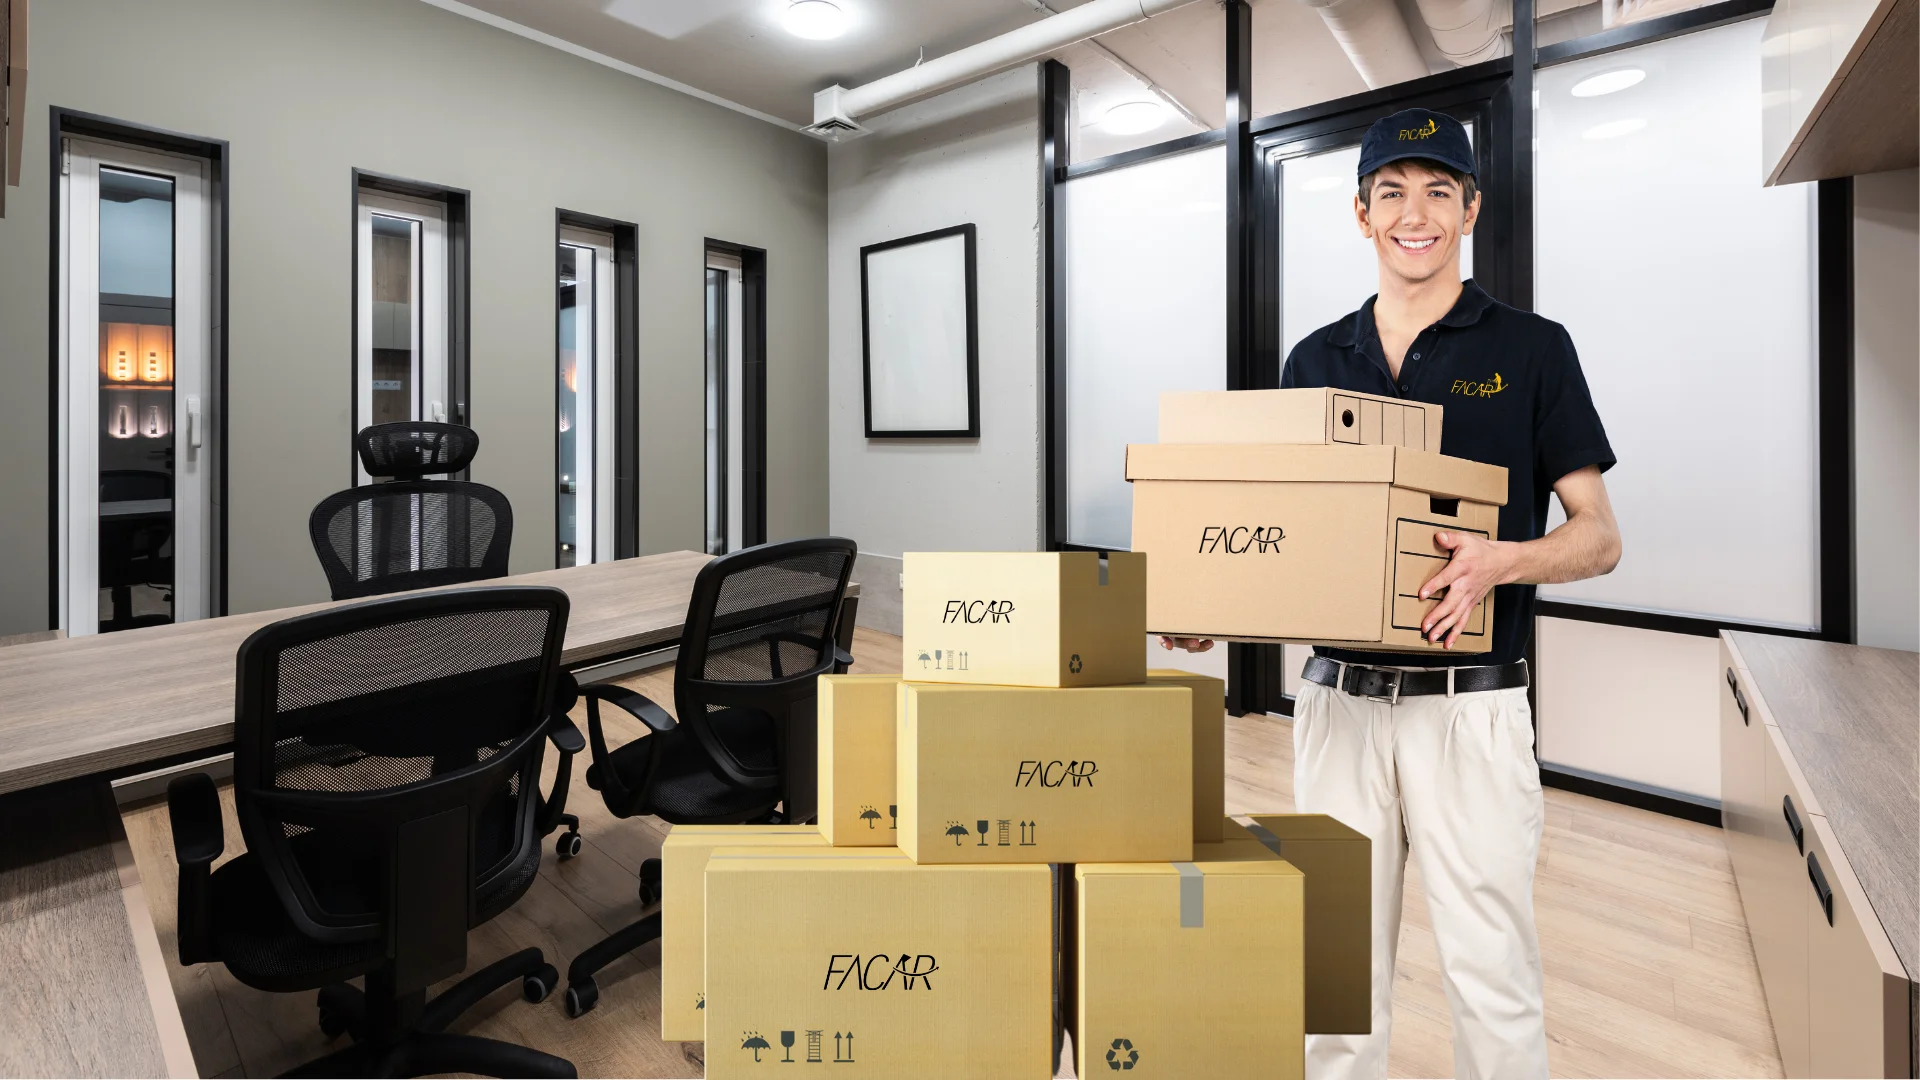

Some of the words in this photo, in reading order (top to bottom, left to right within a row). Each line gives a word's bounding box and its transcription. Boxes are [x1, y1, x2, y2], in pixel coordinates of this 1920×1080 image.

[1398, 125, 1435, 141] FACAR
[1450, 378, 1500, 399] FACAR
[1198, 526, 1286, 554] FACAR
[942, 600, 1015, 623] FACAR
[1015, 760, 1098, 787] FACAR
[823, 953, 940, 991] FACAR
